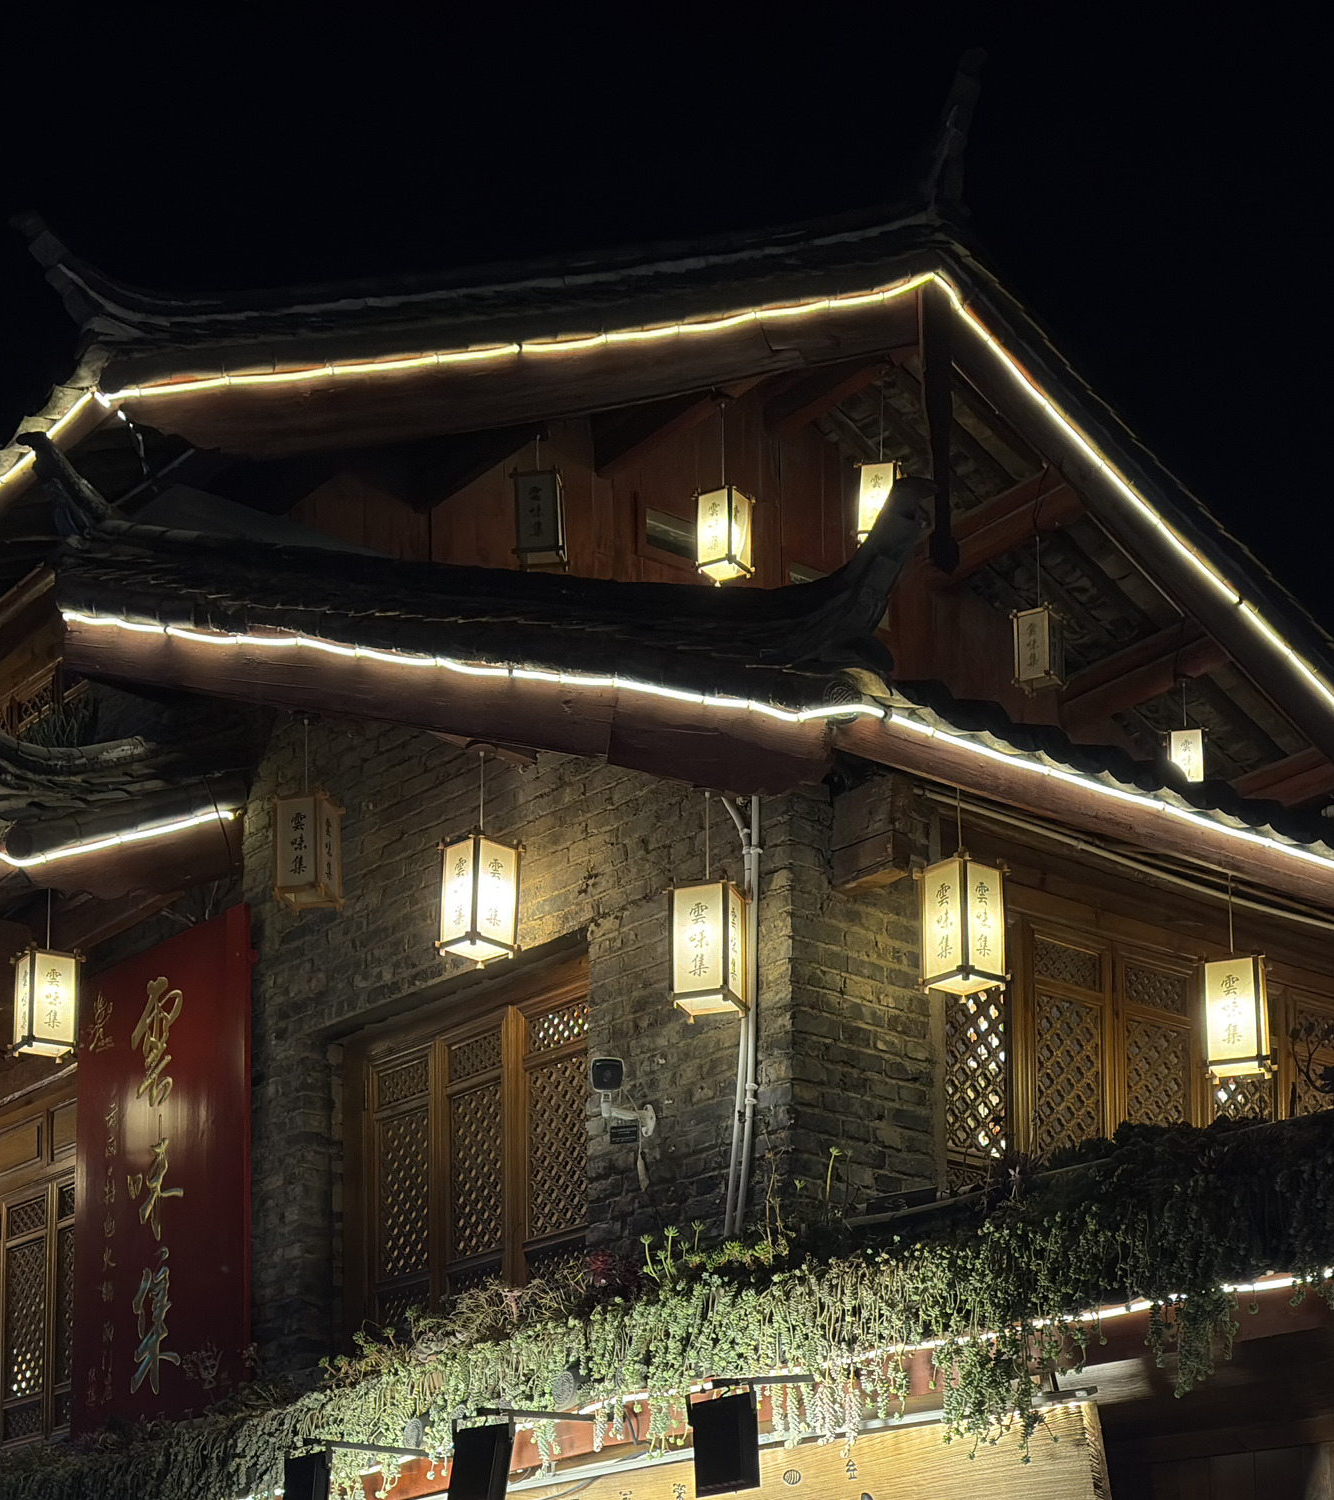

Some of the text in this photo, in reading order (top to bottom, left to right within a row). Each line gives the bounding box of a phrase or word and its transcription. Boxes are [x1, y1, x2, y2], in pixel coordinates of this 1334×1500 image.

[291, 811, 307, 876] 雲味集
[487, 857, 504, 927] 雲集
[936, 881, 953, 959] 雲味集
[688, 901, 710, 979] 雲味集
